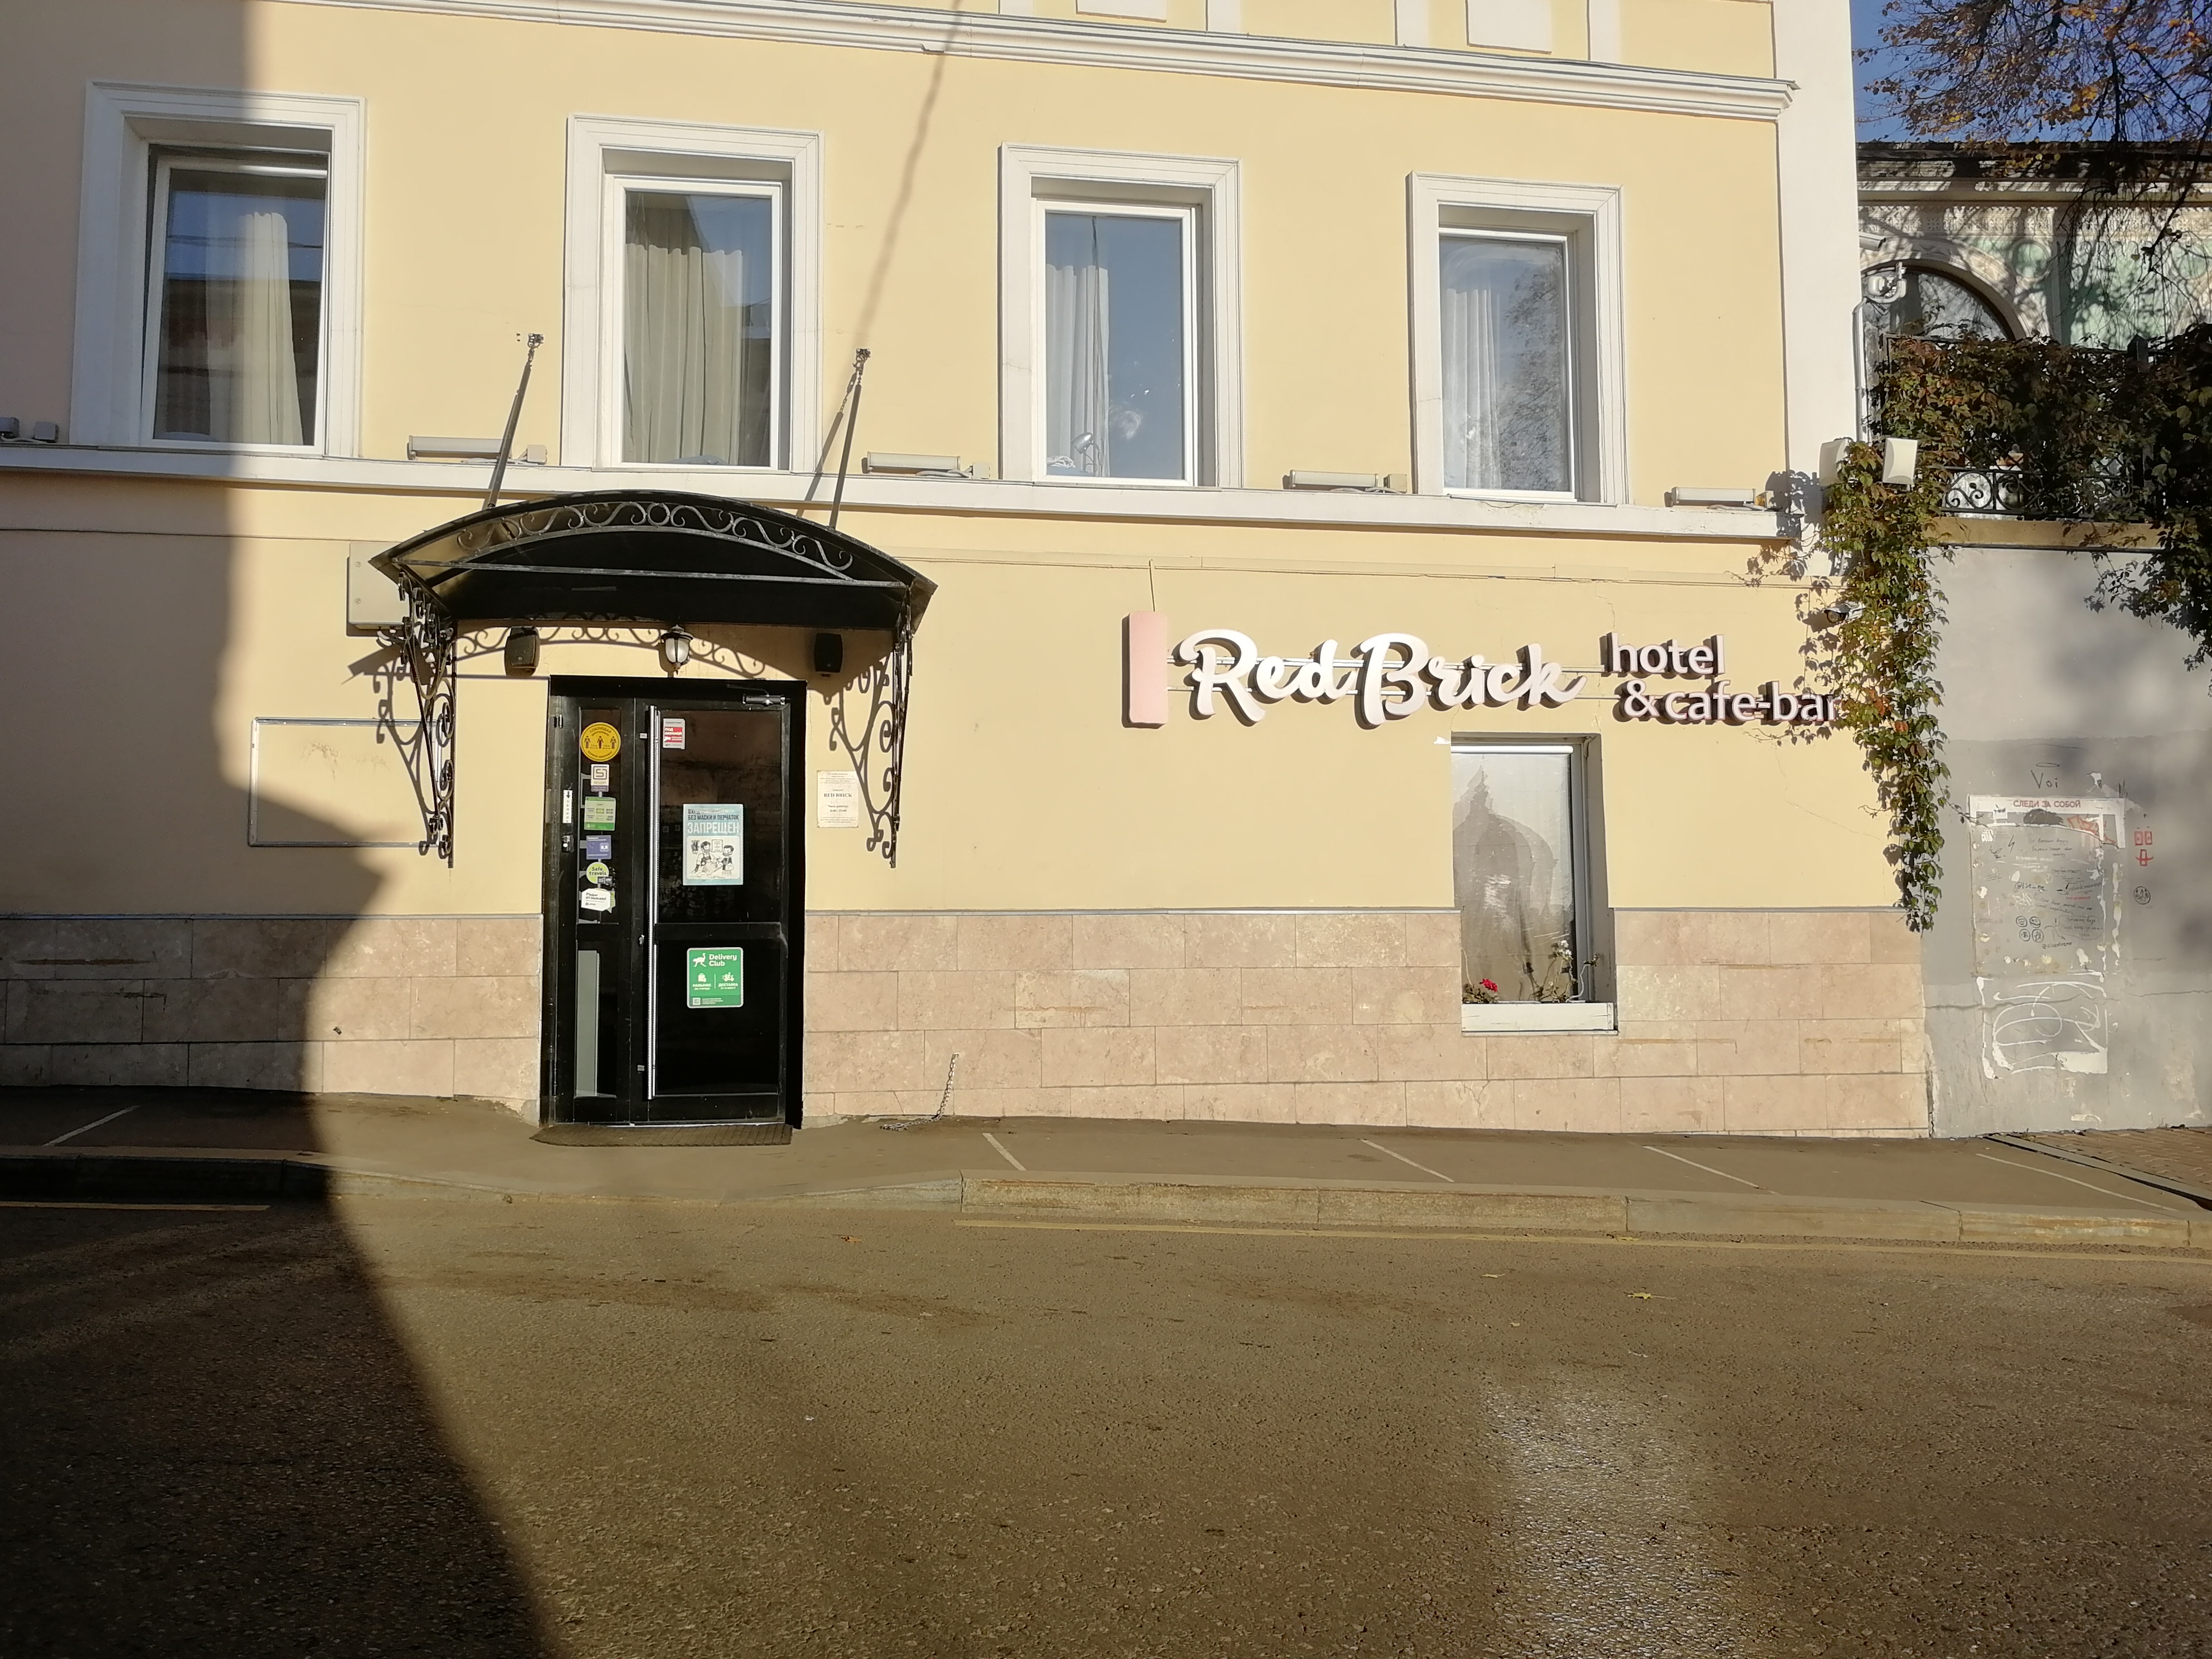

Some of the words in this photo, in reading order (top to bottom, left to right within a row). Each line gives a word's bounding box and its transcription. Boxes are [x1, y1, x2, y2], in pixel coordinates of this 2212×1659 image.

[1608, 632, 1726, 674] hotel
[1177, 628, 1358, 723] Red
[1358, 632, 1589, 726] Brick
[2013, 800, 2040, 808] СЛЕДИ
[2054, 799, 2082, 808] СОБОЙ
[687, 822, 740, 835] ЗАПРЕЩЕН
